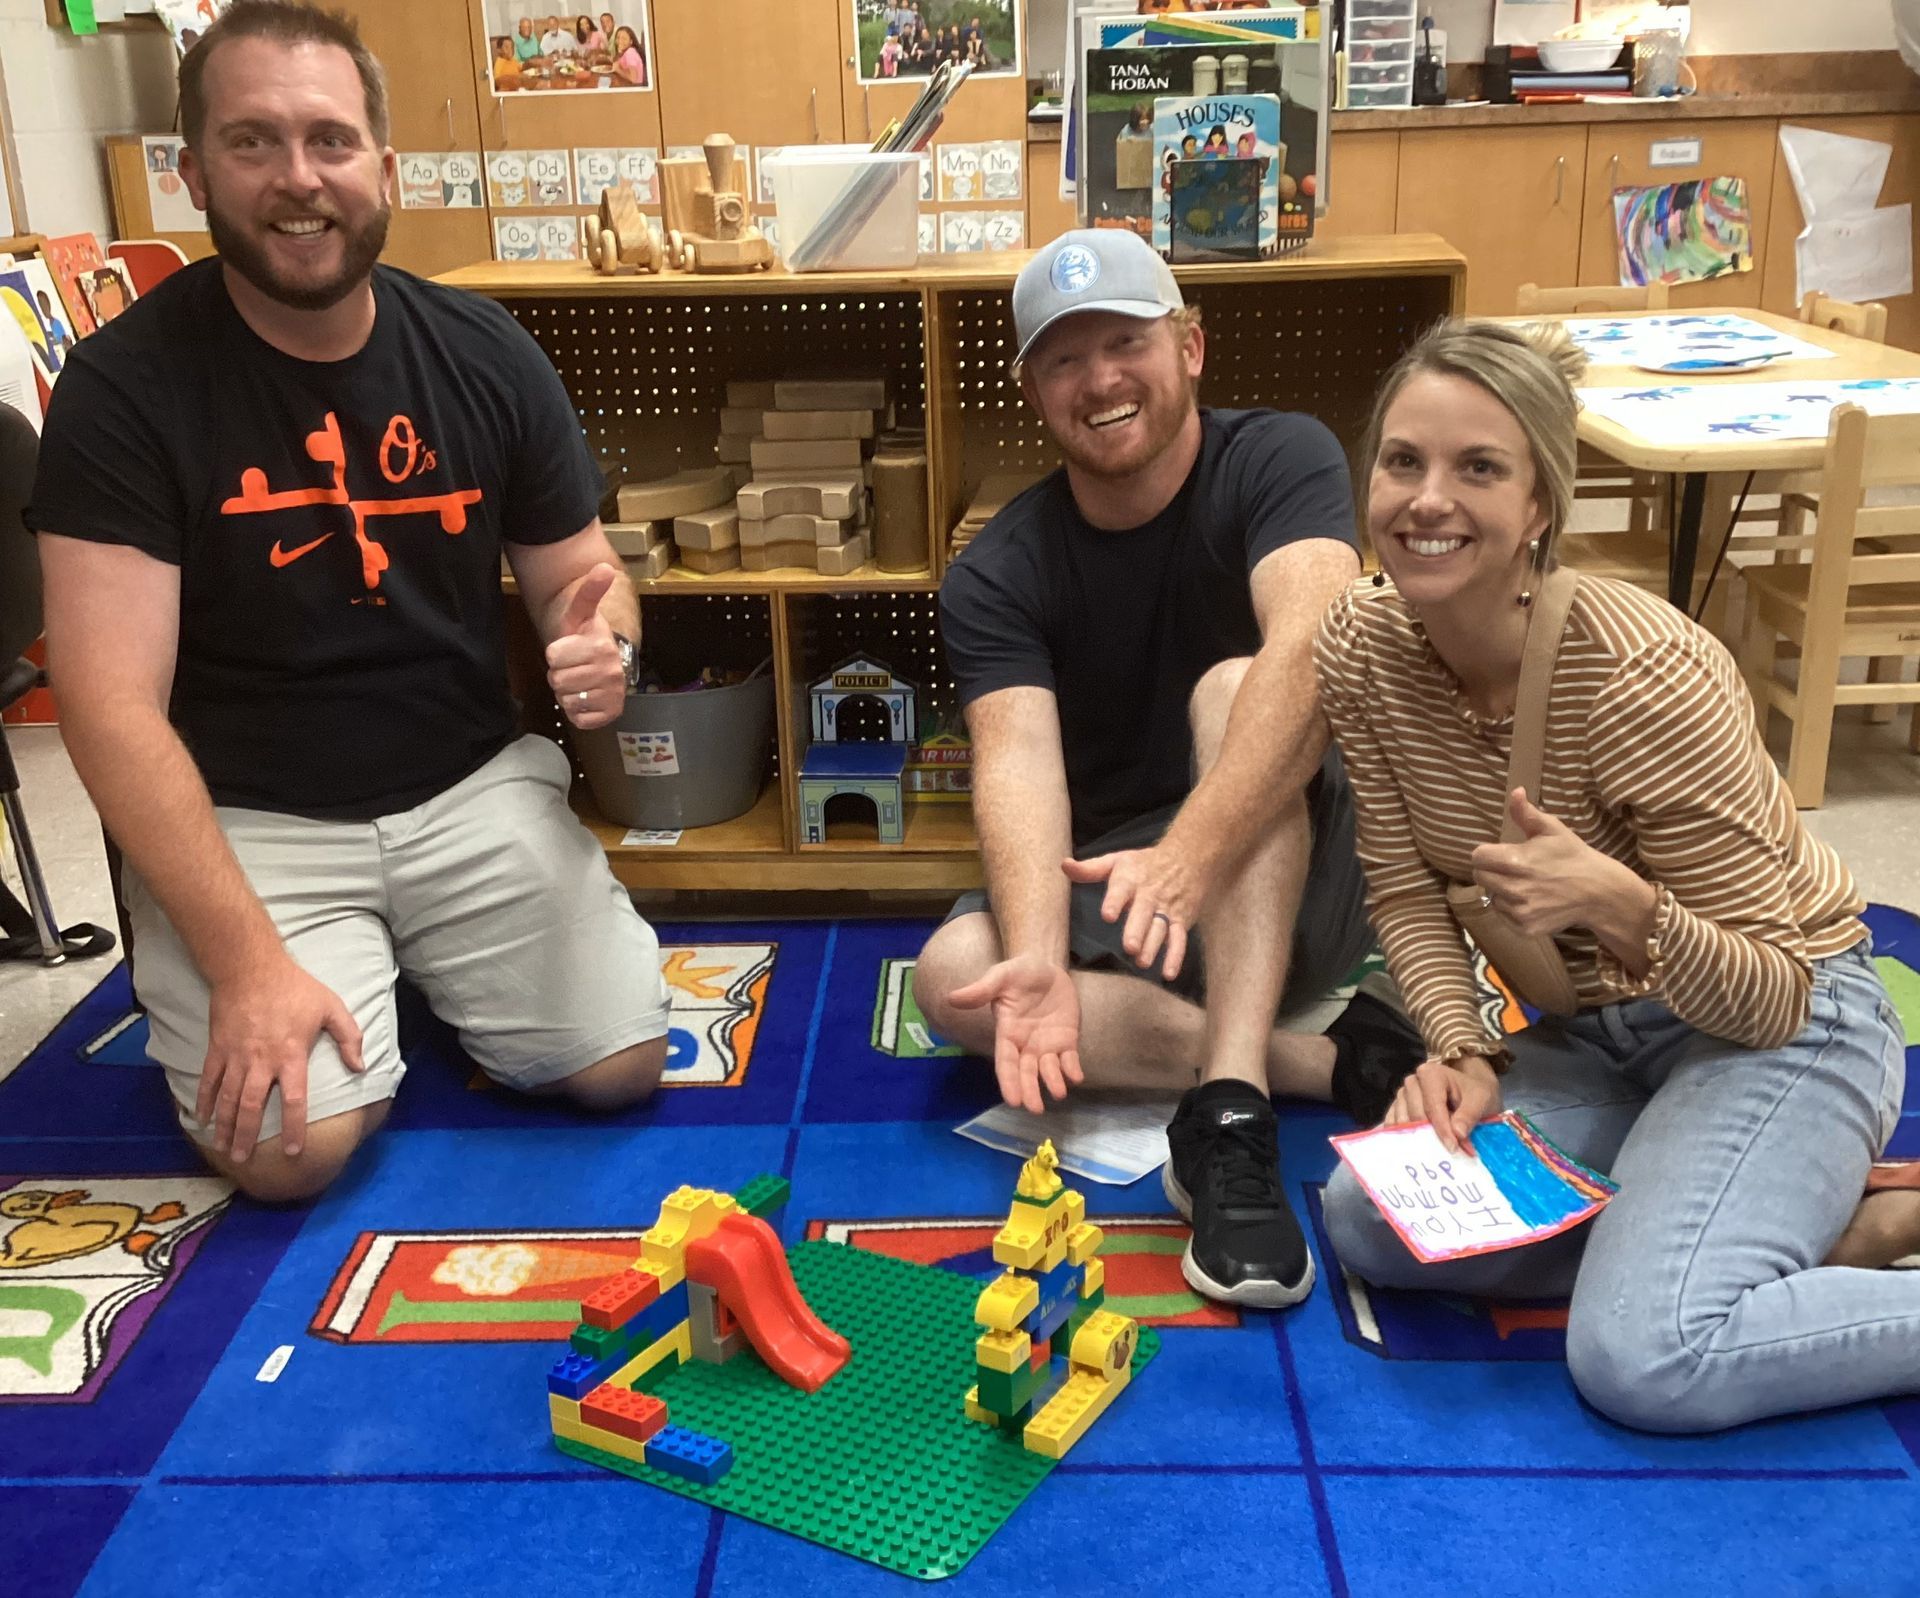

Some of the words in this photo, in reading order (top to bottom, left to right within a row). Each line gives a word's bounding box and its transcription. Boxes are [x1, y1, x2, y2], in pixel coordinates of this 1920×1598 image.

[1109, 64, 1150, 77] TANA
[1111, 77, 1169, 91] HOBAN
[1175, 102, 1256, 130] HOUSES
[411, 163, 433, 179] Aa
[450, 161, 470, 178] Bb
[499, 160, 519, 177] Cc
[537, 159, 558, 176] Dd
[588, 158, 609, 175] Ee
[628, 157, 647, 174] Ff
[947, 154, 976, 171] Mm
[990, 153, 1012, 170] Nn
[508, 226, 530, 243] Oo
[548, 226, 568, 246] Pp
[954, 221, 973, 242] Yy
[994, 221, 1013, 238] Zz
[837, 676, 887, 686] POLICE
